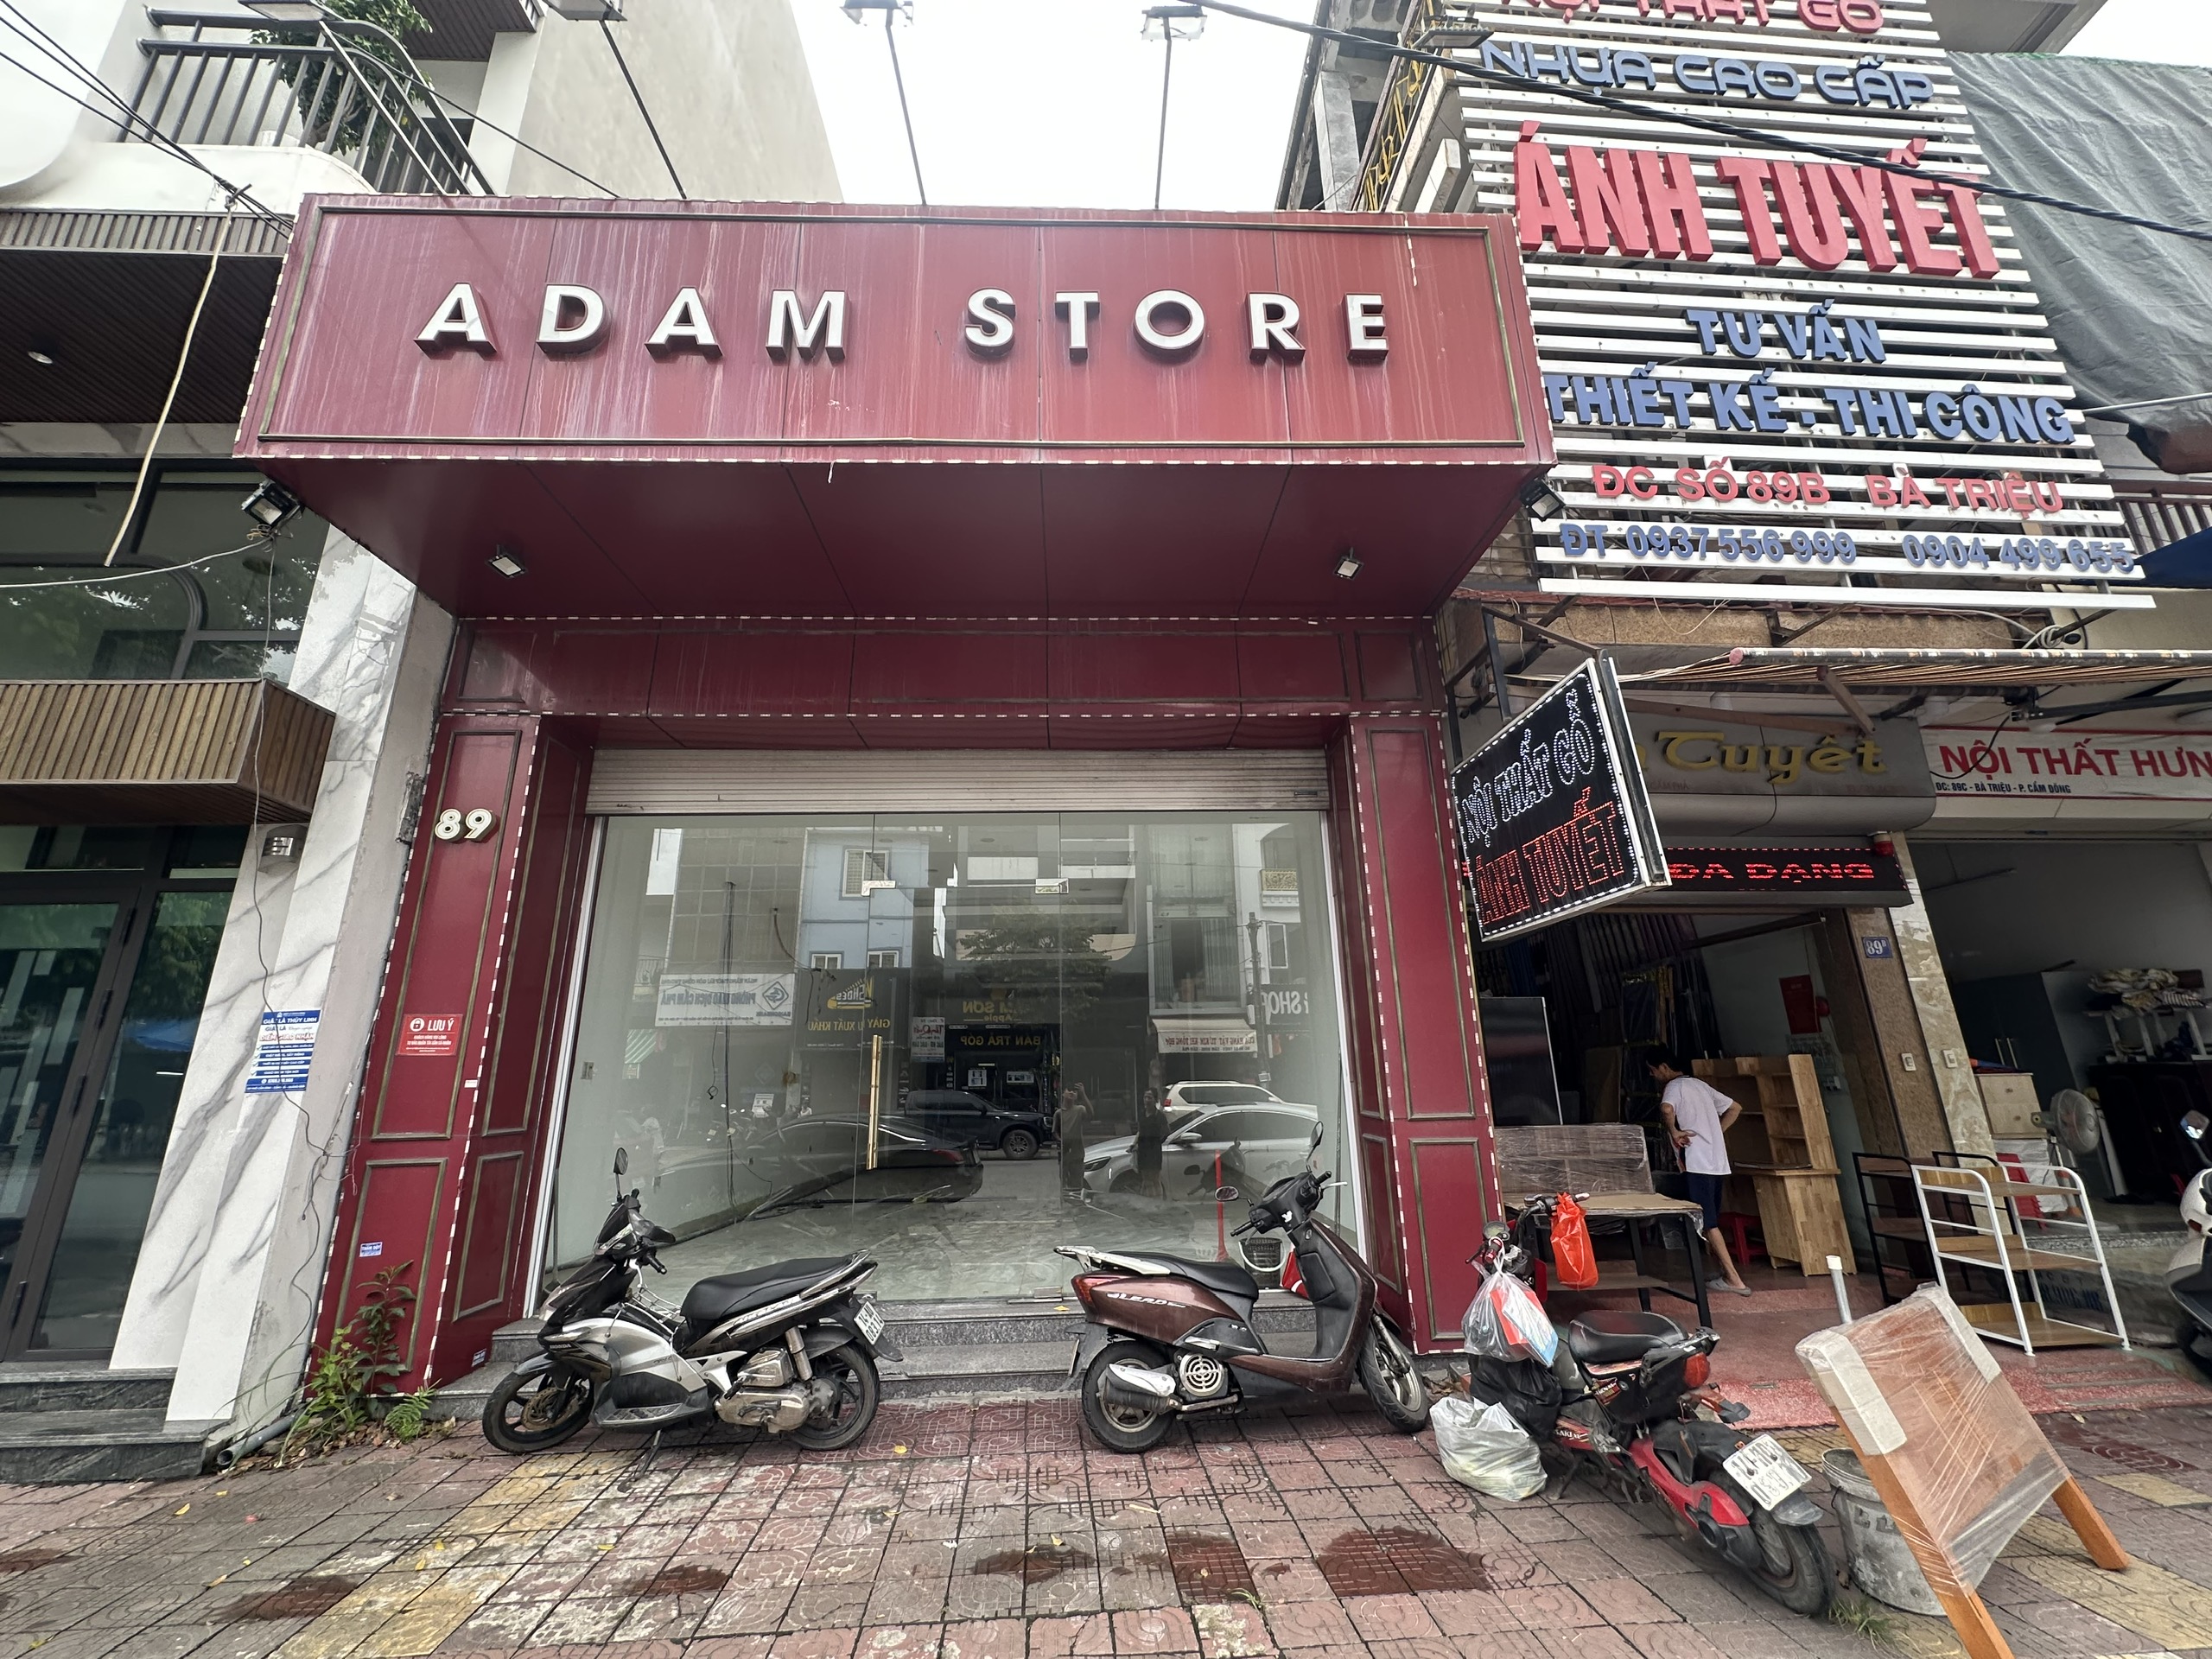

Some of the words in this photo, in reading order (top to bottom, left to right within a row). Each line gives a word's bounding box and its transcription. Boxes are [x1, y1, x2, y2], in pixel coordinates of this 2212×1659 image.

[1480, 40, 1656, 96] NHỰA
[1674, 54, 1802, 101] CAO
[1815, 54, 1936, 109] CẤP
[1512, 119, 1714, 262] ÁNH
[1715, 137, 2000, 279] TUYẾT
[414, 282, 851, 363] ADAM
[963, 288, 1391, 361] STORE
[1685, 308, 1764, 359] TƯ
[1774, 298, 1887, 364] VẤN
[1544, 361, 1694, 430] THIẾT
[1707, 368, 1789, 433] KẾ
[1822, 386, 1919, 439] THI
[1921, 384, 2077, 445] CÔNG
[1592, 464, 1658, 501] ĐC
[1675, 455, 1739, 503] SỐ
[1746, 470, 1831, 505] 89B
[1865, 467, 1932, 509] BÀ
[1935, 471, 2063, 519] TRIỆU
[1560, 523, 1609, 557] ĐT
[1625, 523, 1708, 560] 0937
[1718, 526, 1785, 563] 556
[1792, 530, 1857, 565] 999
[1902, 533, 1990, 570] 0904
[1999, 537, 2063, 572] 499
[2065, 538, 2135, 575] 655
[1553, 688, 1596, 785] GỖ
[1939, 739, 2013, 781] NỘI
[2016, 737, 2120, 776] THẤT
[1951, 782, 1968, 791] 89C
[1987, 781, 2012, 794] TRIỆU
[2018, 783, 2027, 792] P.
[435, 807, 495, 842] 89
[1522, 786, 1624, 904] TUYẾT
[1745, 863, 1874, 883] DẠNG
[448, 1018, 454, 1031] Ý
